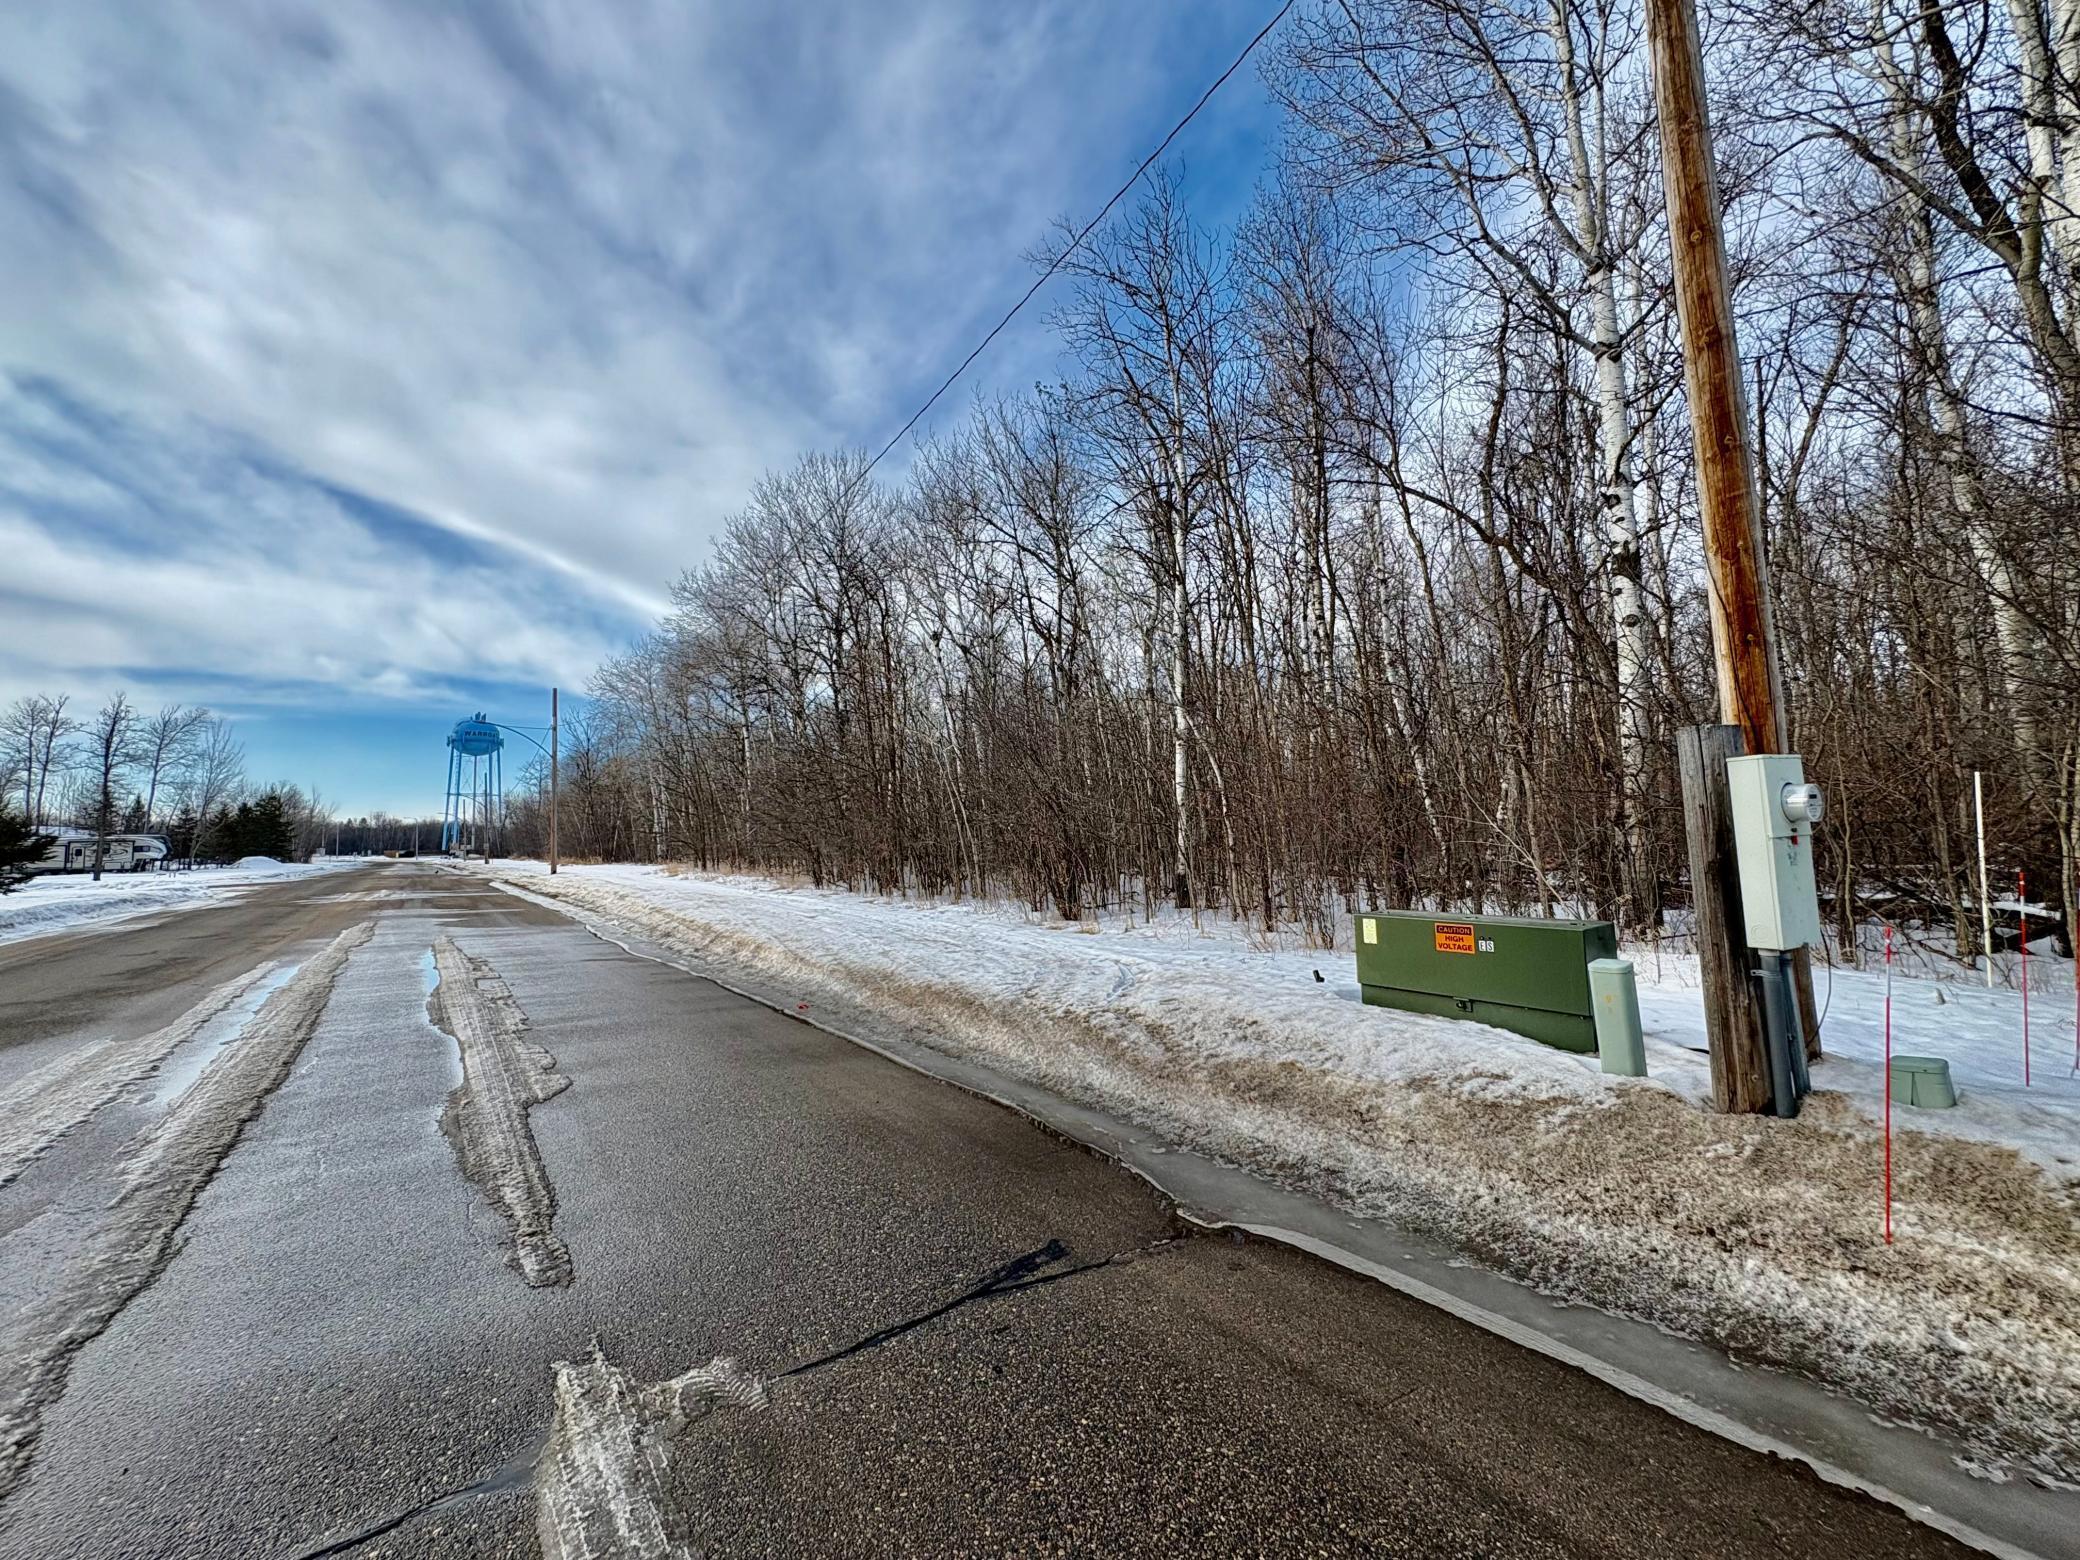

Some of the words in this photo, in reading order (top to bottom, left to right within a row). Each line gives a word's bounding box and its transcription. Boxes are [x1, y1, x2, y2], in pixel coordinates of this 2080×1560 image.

[1437, 926, 1470, 935] CAUTION
[1444, 935, 1465, 943] HIGH
[1437, 942, 1473, 952] VOLTAGE
